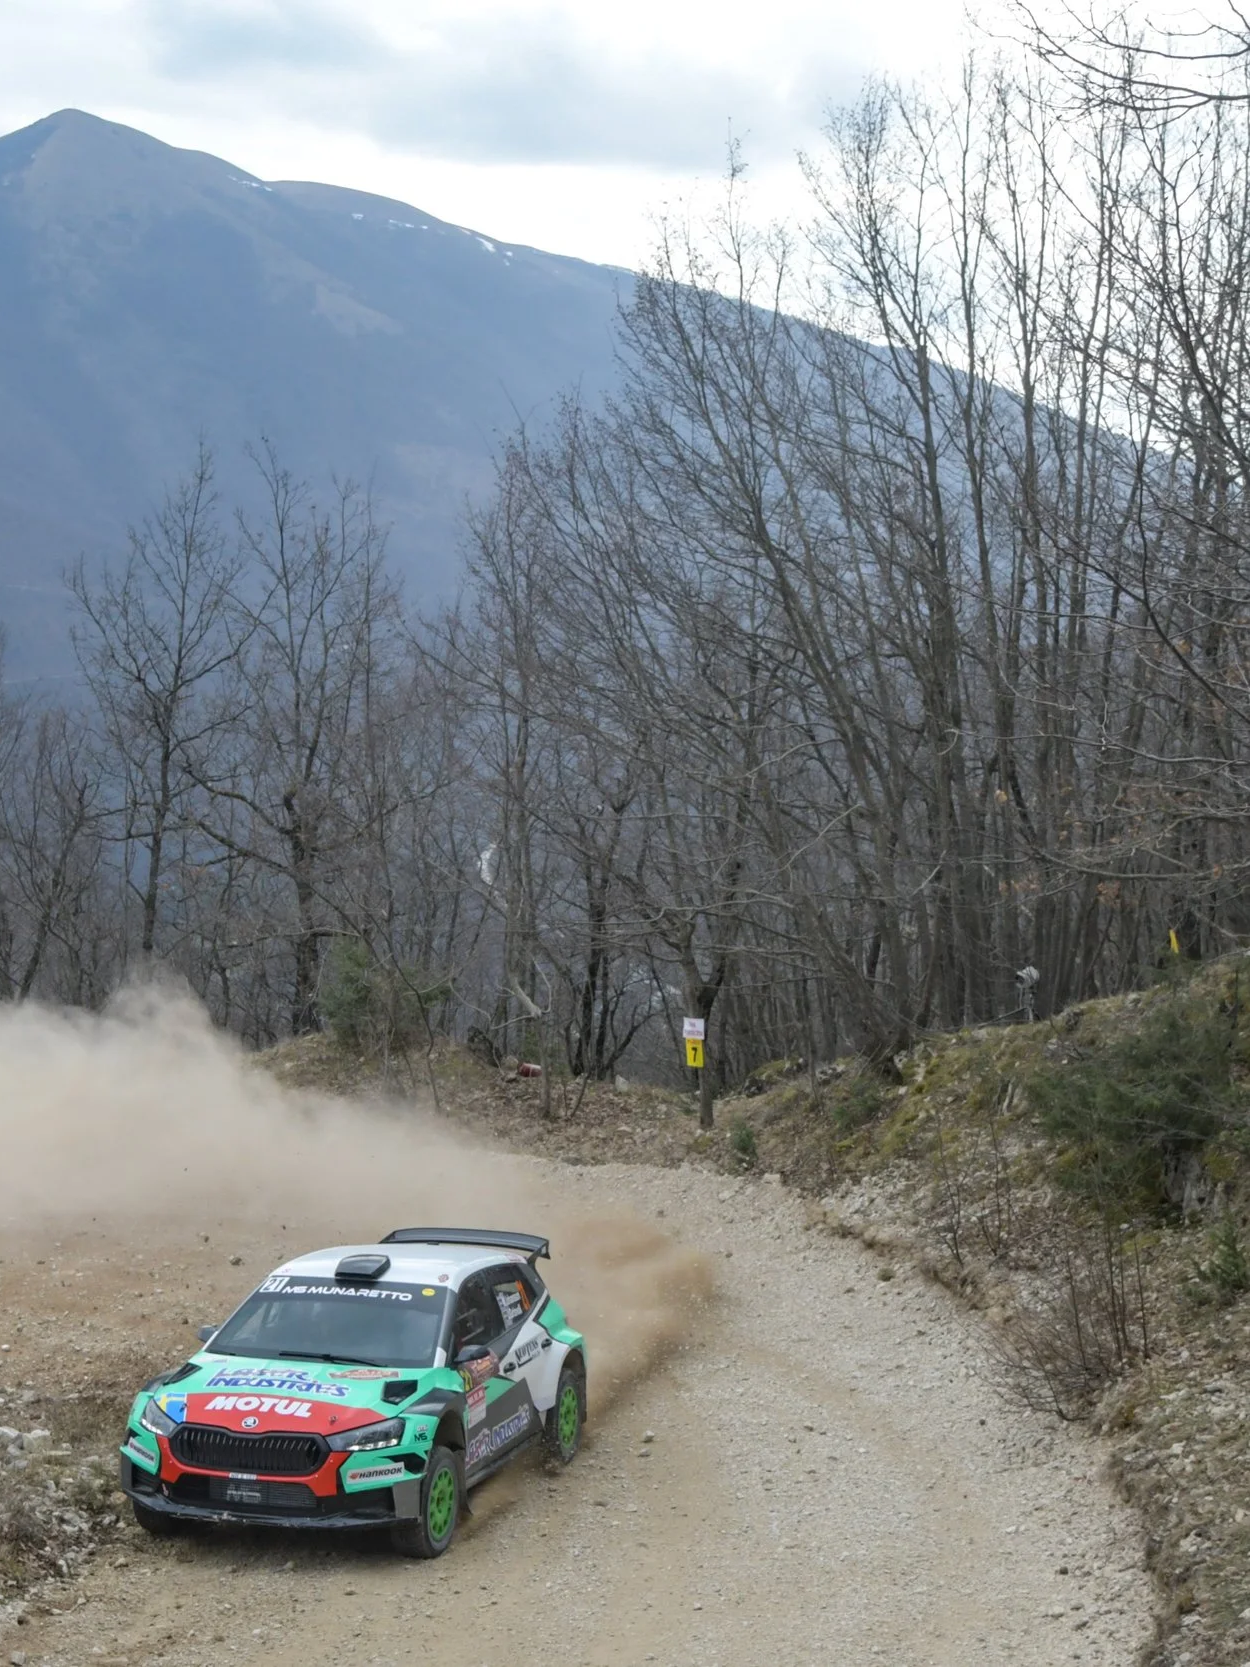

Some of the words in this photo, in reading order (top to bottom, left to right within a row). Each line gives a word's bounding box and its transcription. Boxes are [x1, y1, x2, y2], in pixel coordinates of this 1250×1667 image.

[262, 1278, 285, 1291] 21
[308, 1287, 412, 1301] MUNARETTO
[205, 1377, 349, 1397] INDUSTRIES
[205, 1396, 313, 1418] MOTUL
